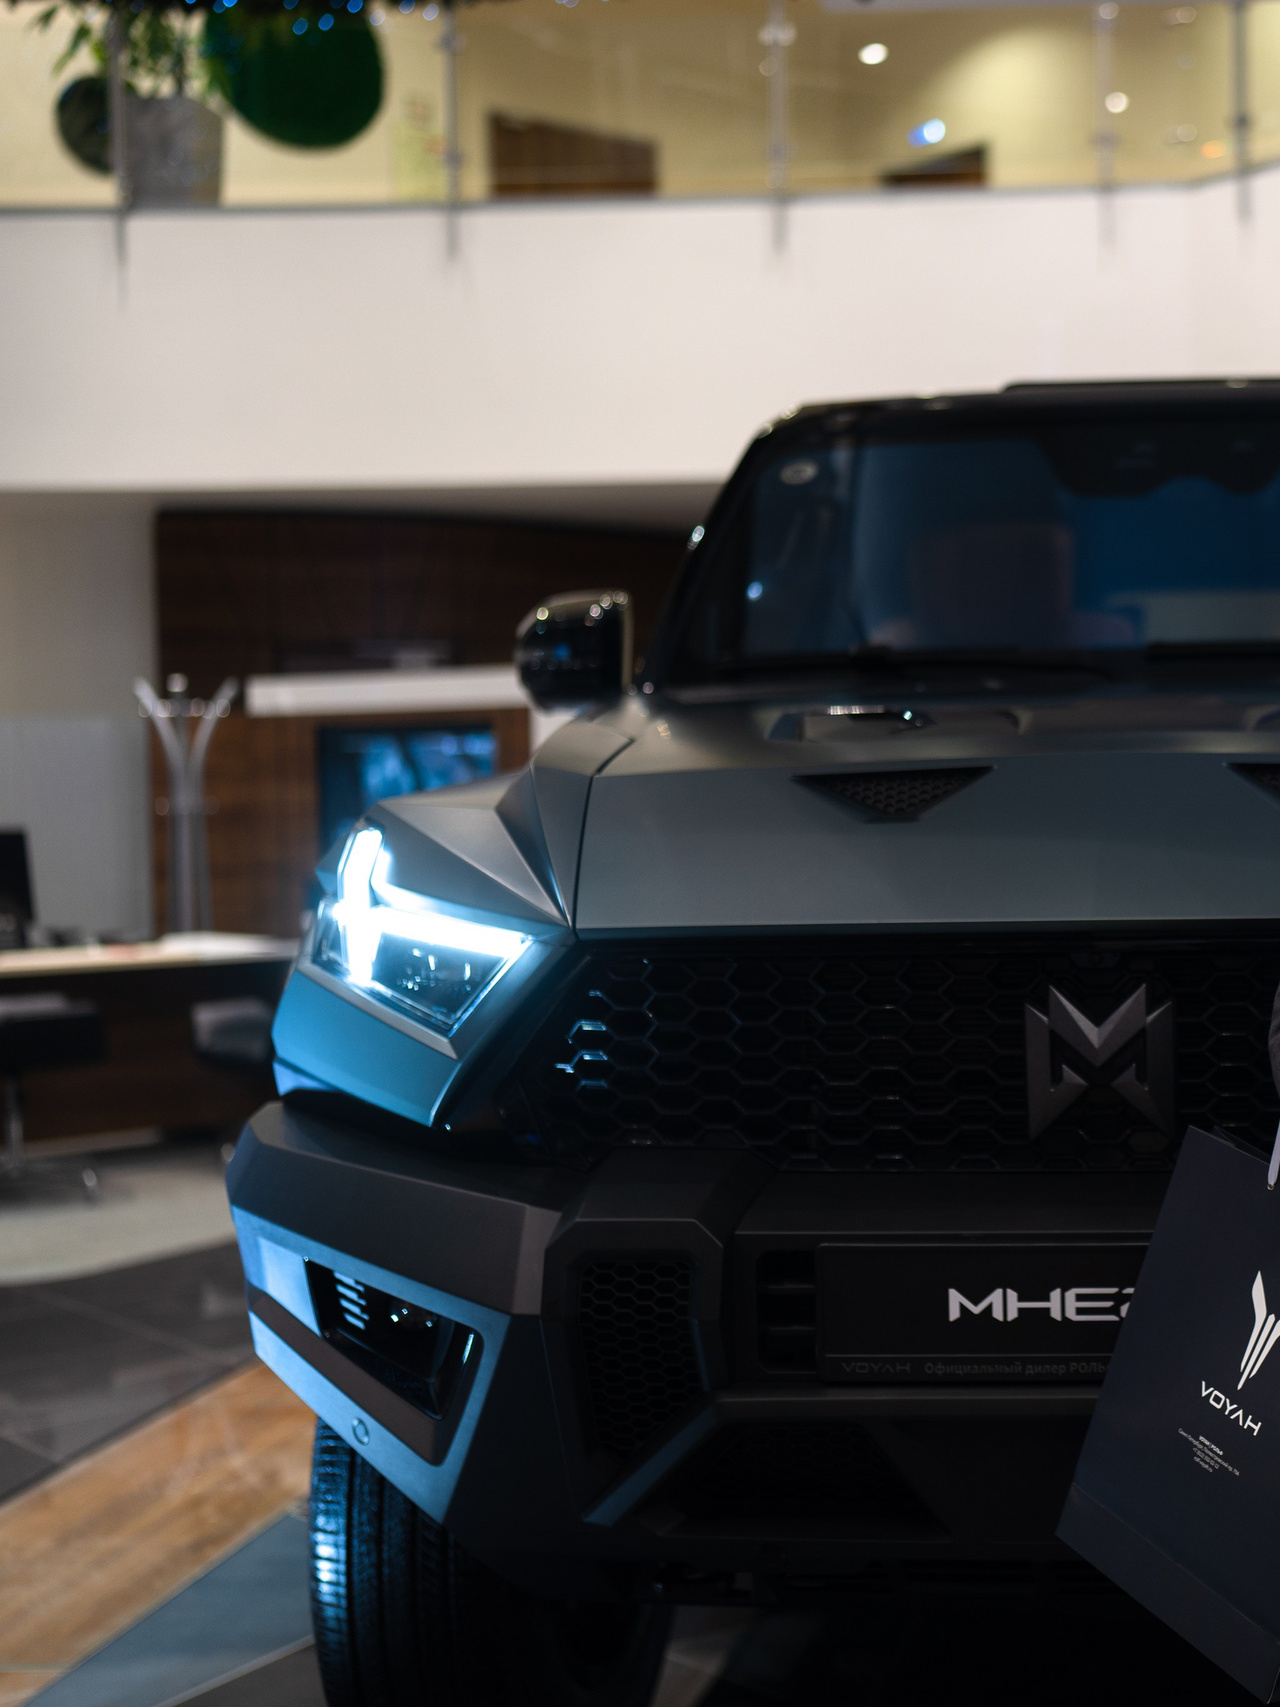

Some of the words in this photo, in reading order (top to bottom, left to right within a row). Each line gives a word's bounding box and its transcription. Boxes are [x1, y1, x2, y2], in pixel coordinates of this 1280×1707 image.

[841, 1362, 911, 1374] VOYAH
[924, 1361, 1023, 1376] Официальный
[1025, 1364, 1067, 1376] дилер
[1201, 1380, 1262, 1436] VOYAH
